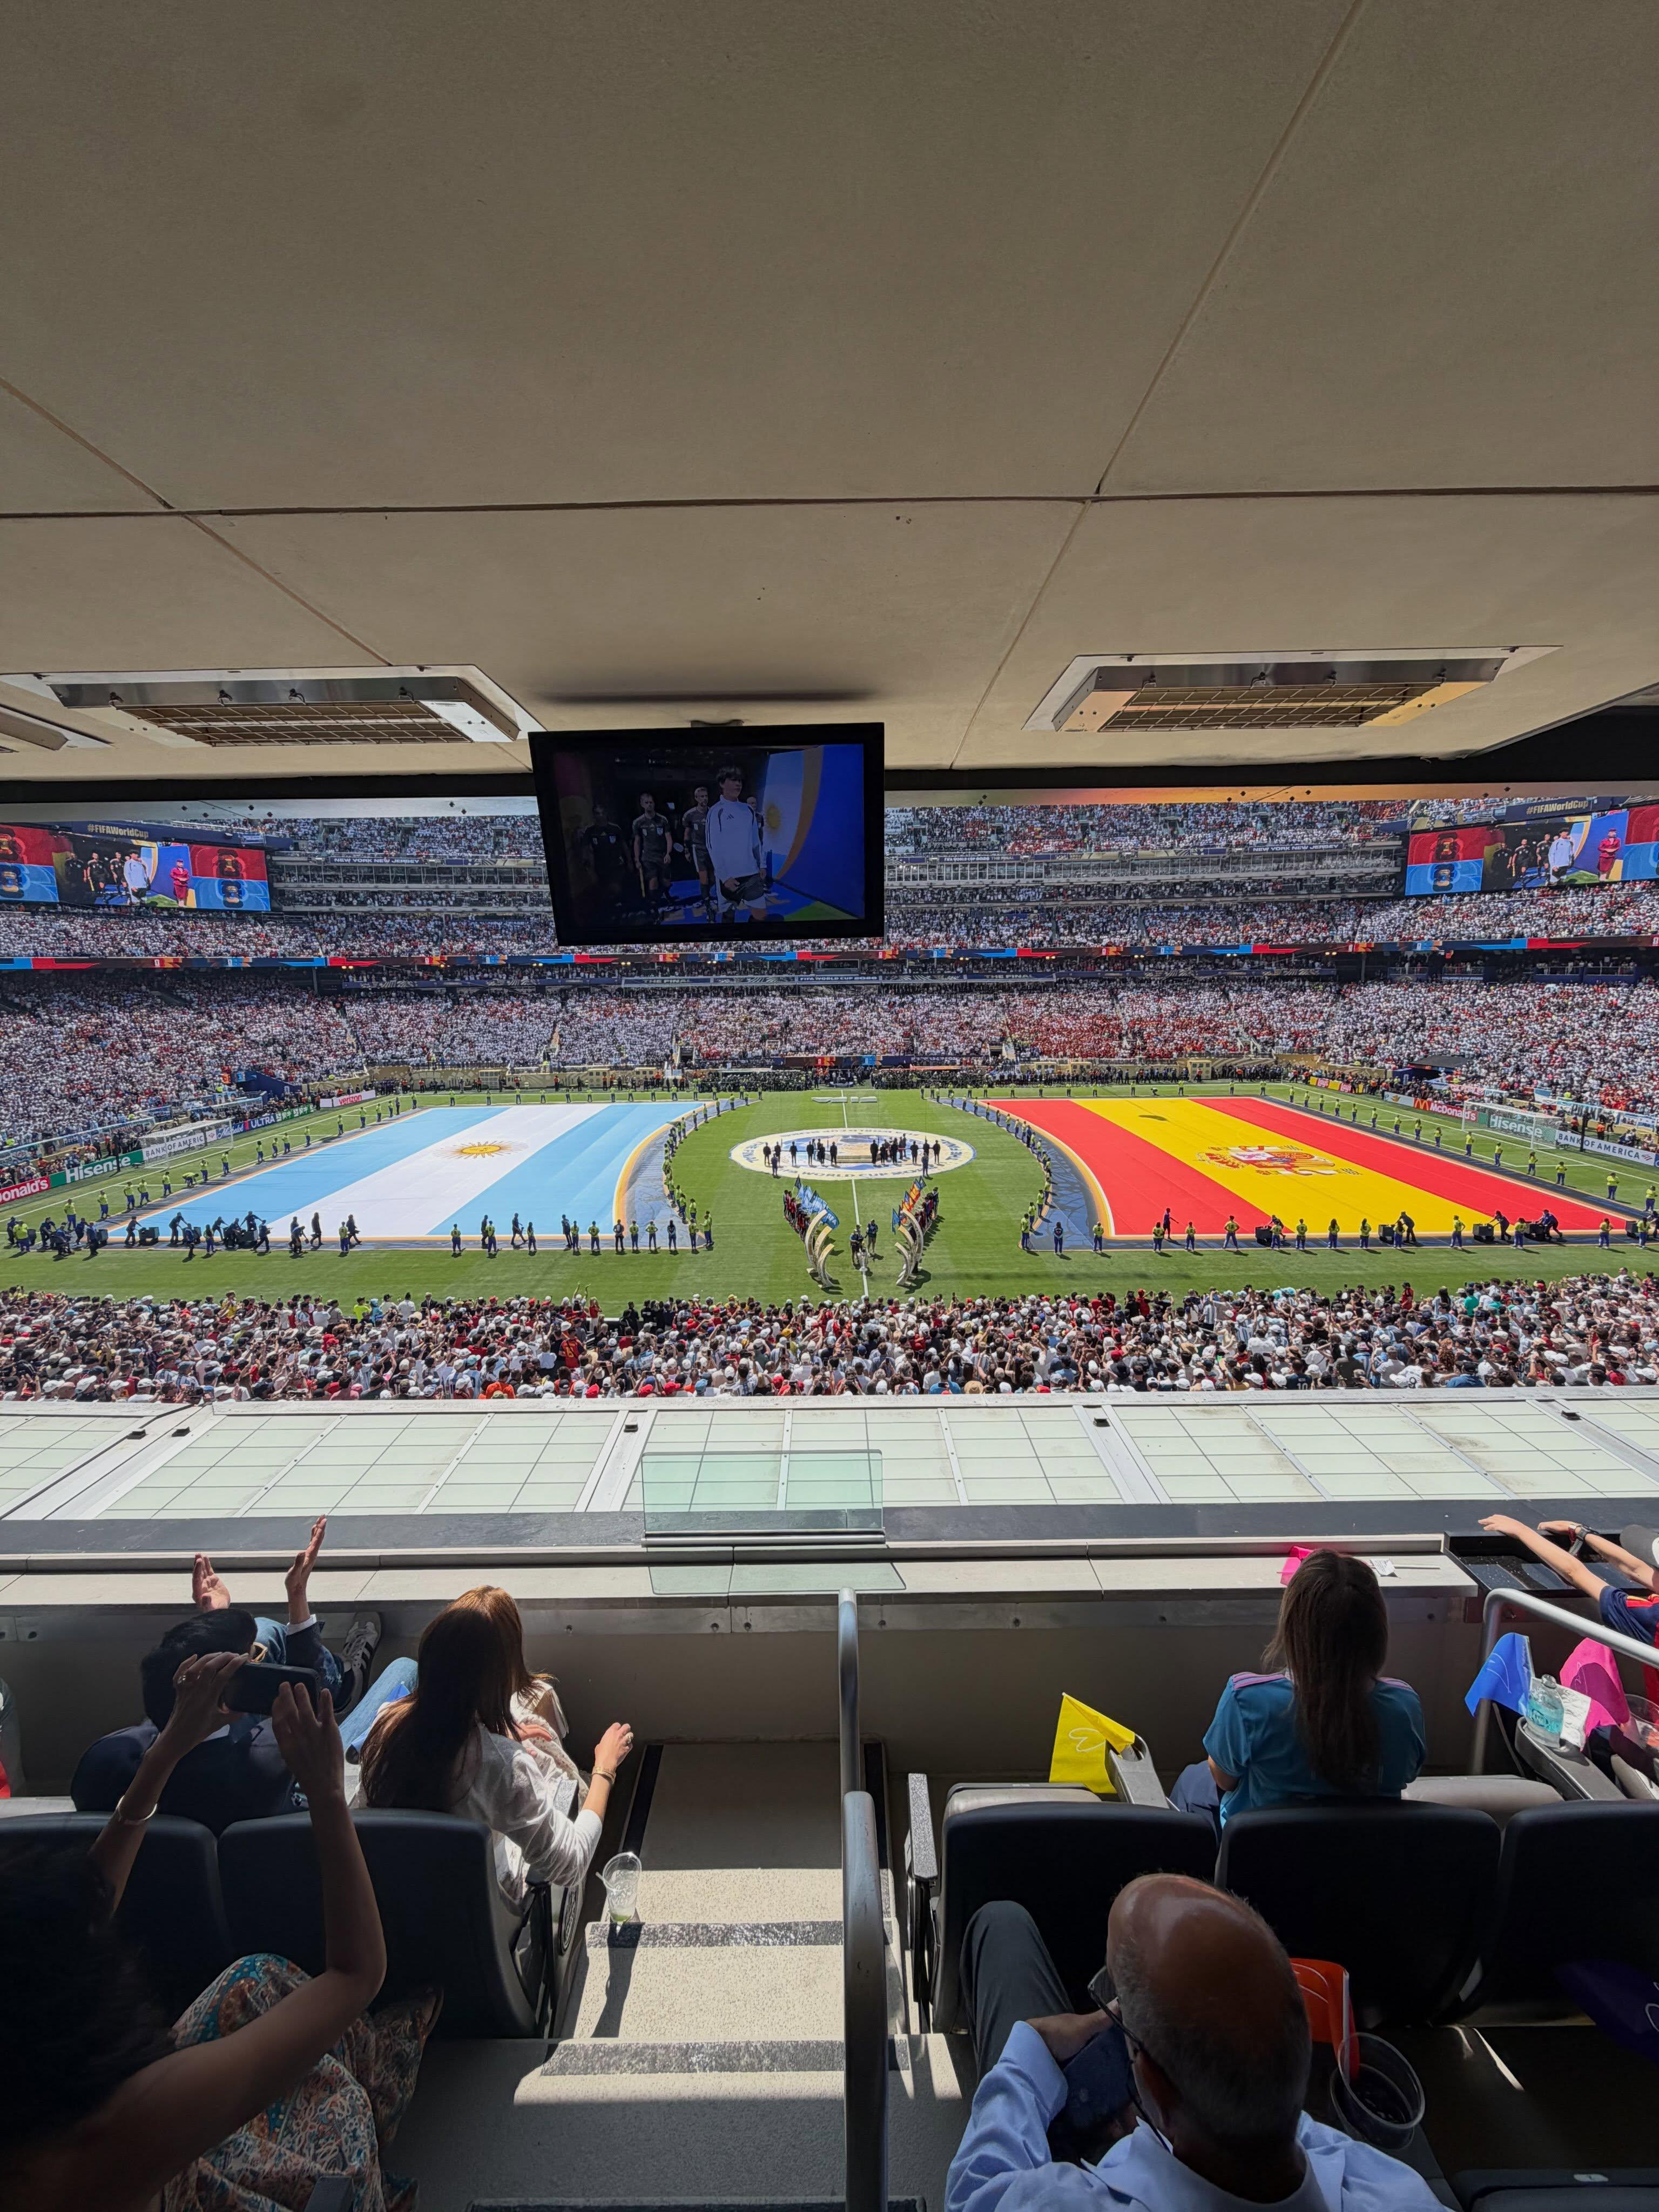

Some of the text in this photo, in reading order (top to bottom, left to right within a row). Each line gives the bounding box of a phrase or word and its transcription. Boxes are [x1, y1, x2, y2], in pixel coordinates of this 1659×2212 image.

[1526, 800, 1588, 815] #FIFAWorldCup
[87, 824, 149, 839] #FIFAWorldCup
[339, 1094, 362, 1105] verizon
[1429, 1102, 1476, 1121] McDonad's
[251, 1115, 275, 1129] ULTRA
[1490, 1114, 1543, 1138] Hisense
[145, 1135, 204, 1157] BANK OF AMERIC
[1559, 1133, 1640, 1159] BANK OF AMERICA
